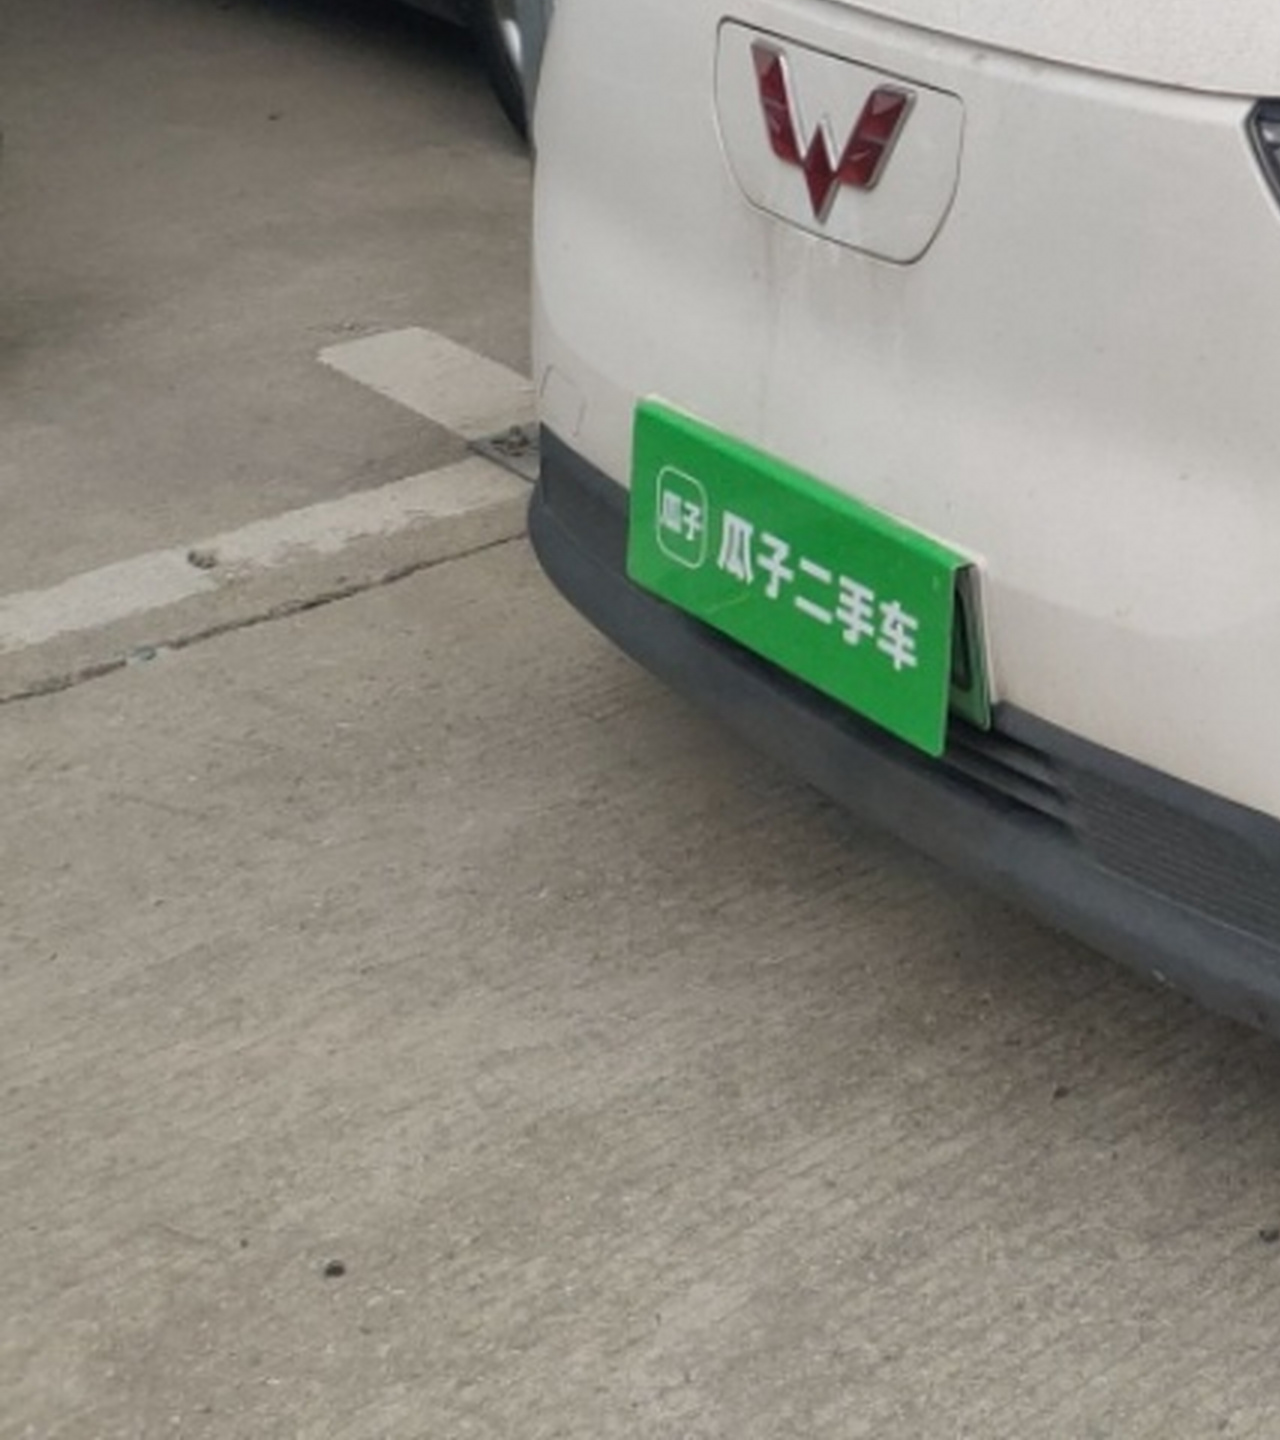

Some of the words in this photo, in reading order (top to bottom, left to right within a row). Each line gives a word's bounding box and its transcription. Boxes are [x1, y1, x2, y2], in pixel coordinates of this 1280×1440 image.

[717, 510, 918, 671] 瓜子二手车
